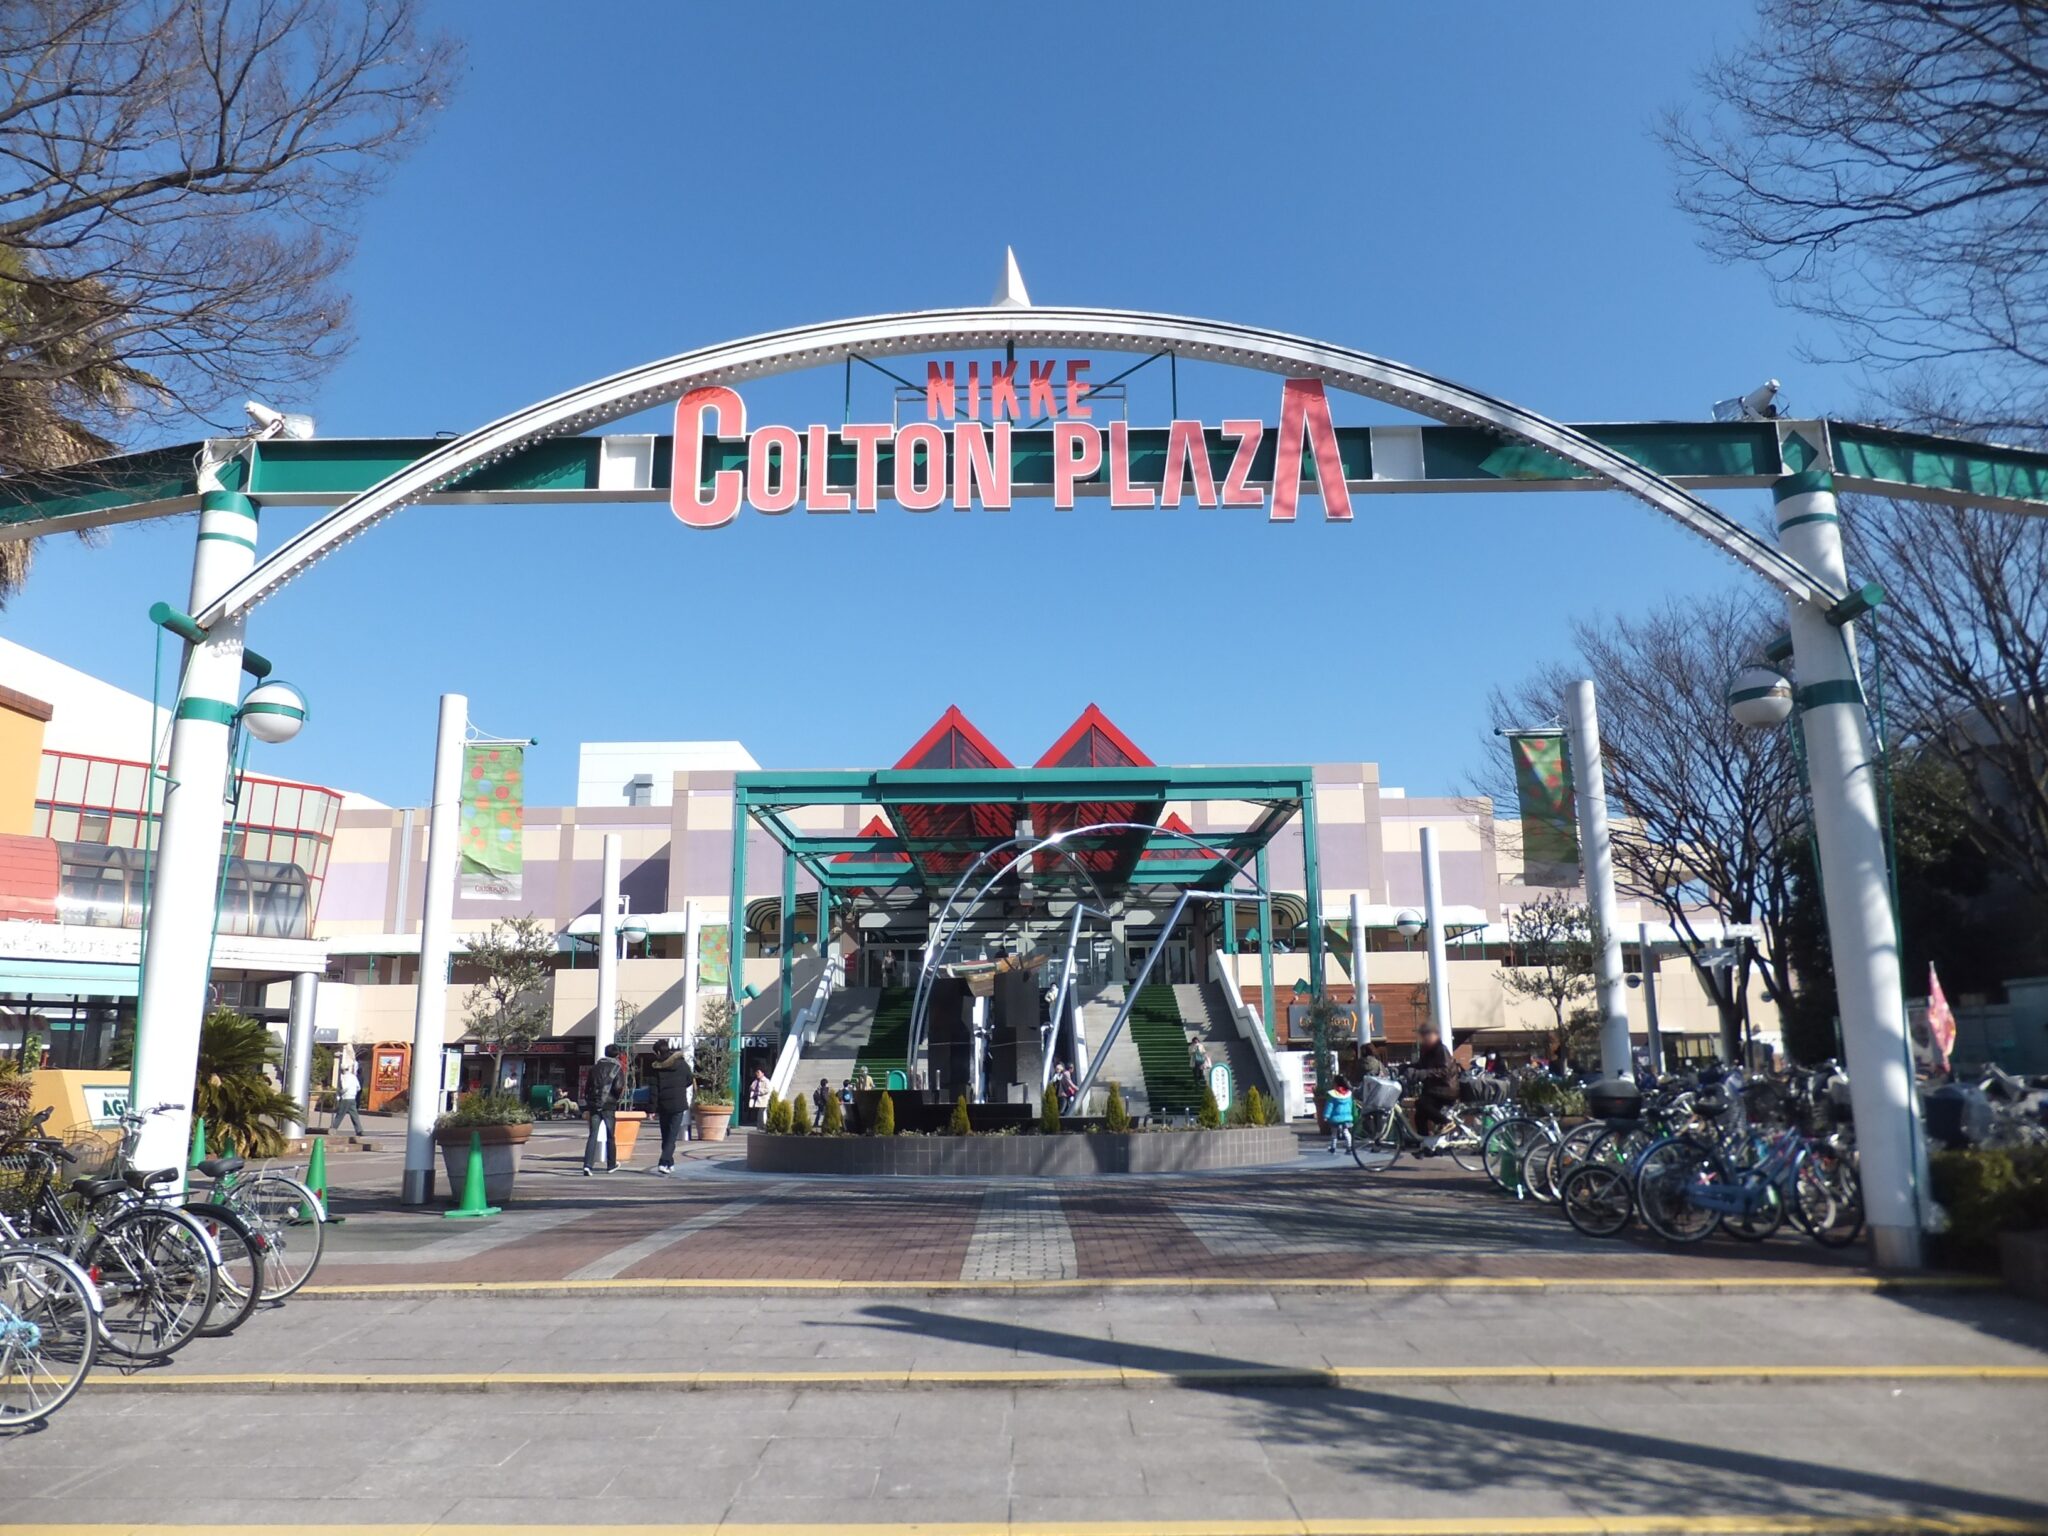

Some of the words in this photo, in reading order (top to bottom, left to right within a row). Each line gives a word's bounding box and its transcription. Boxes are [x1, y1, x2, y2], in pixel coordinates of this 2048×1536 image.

[928, 360, 1092, 419] NIKKE
[670, 385, 1012, 529] COLTON
[1053, 378, 1354, 522] PLAZA
